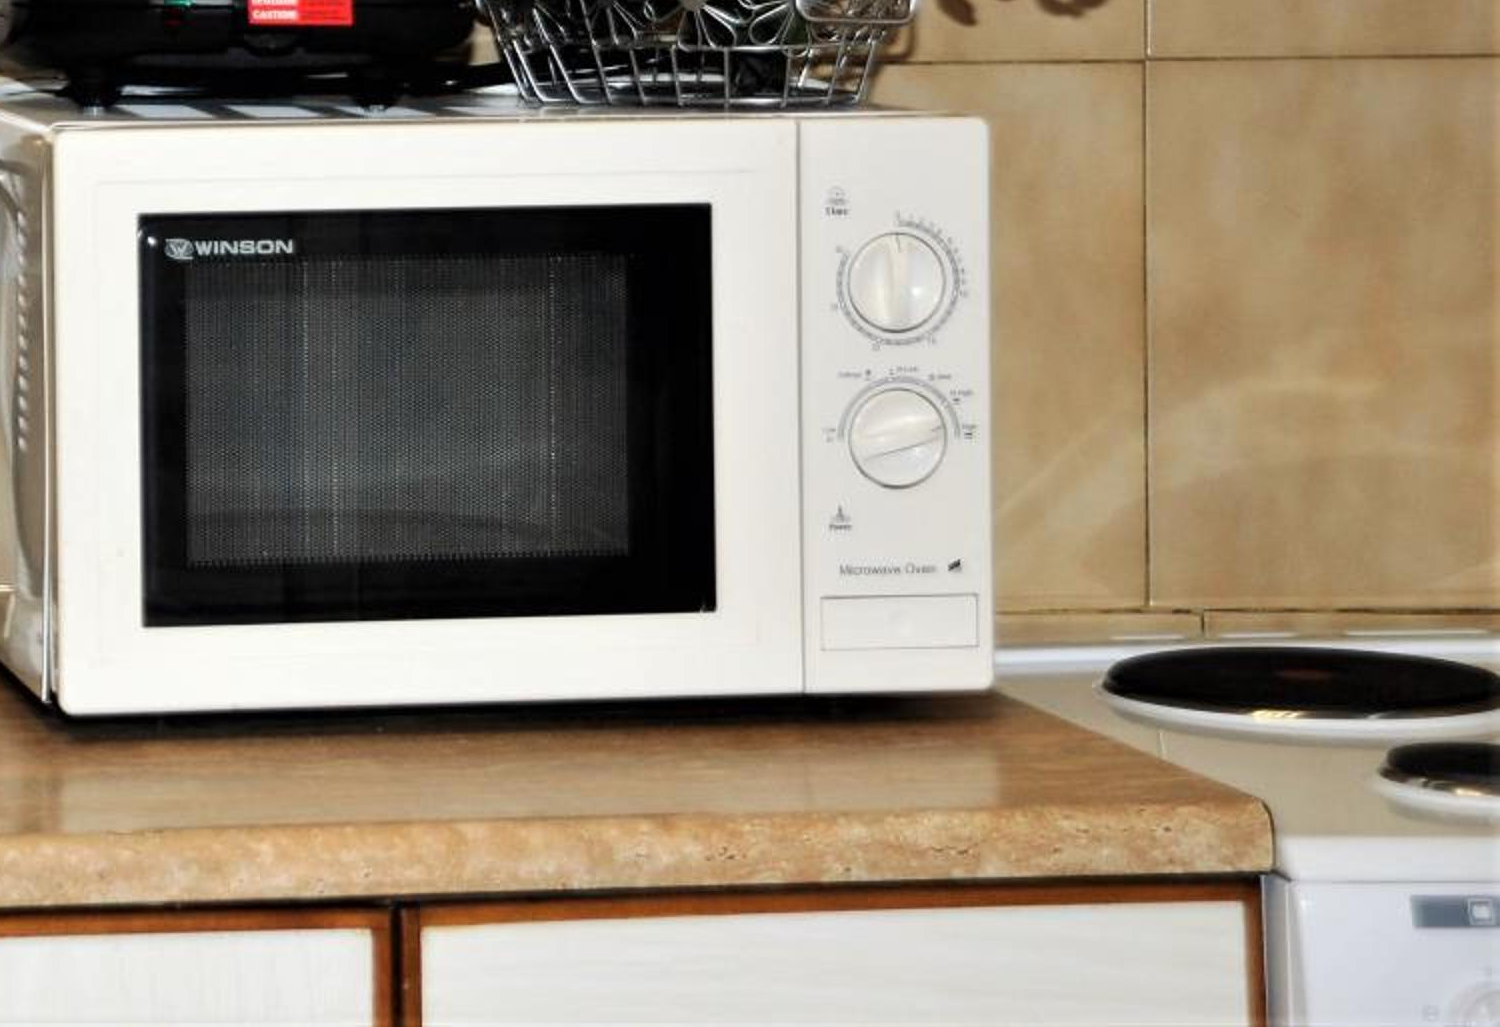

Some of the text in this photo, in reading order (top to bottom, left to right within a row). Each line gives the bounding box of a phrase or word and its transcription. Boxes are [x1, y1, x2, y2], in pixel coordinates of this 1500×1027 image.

[194, 238, 293, 255] WINSON
[839, 561, 937, 576] Microwave Oven
